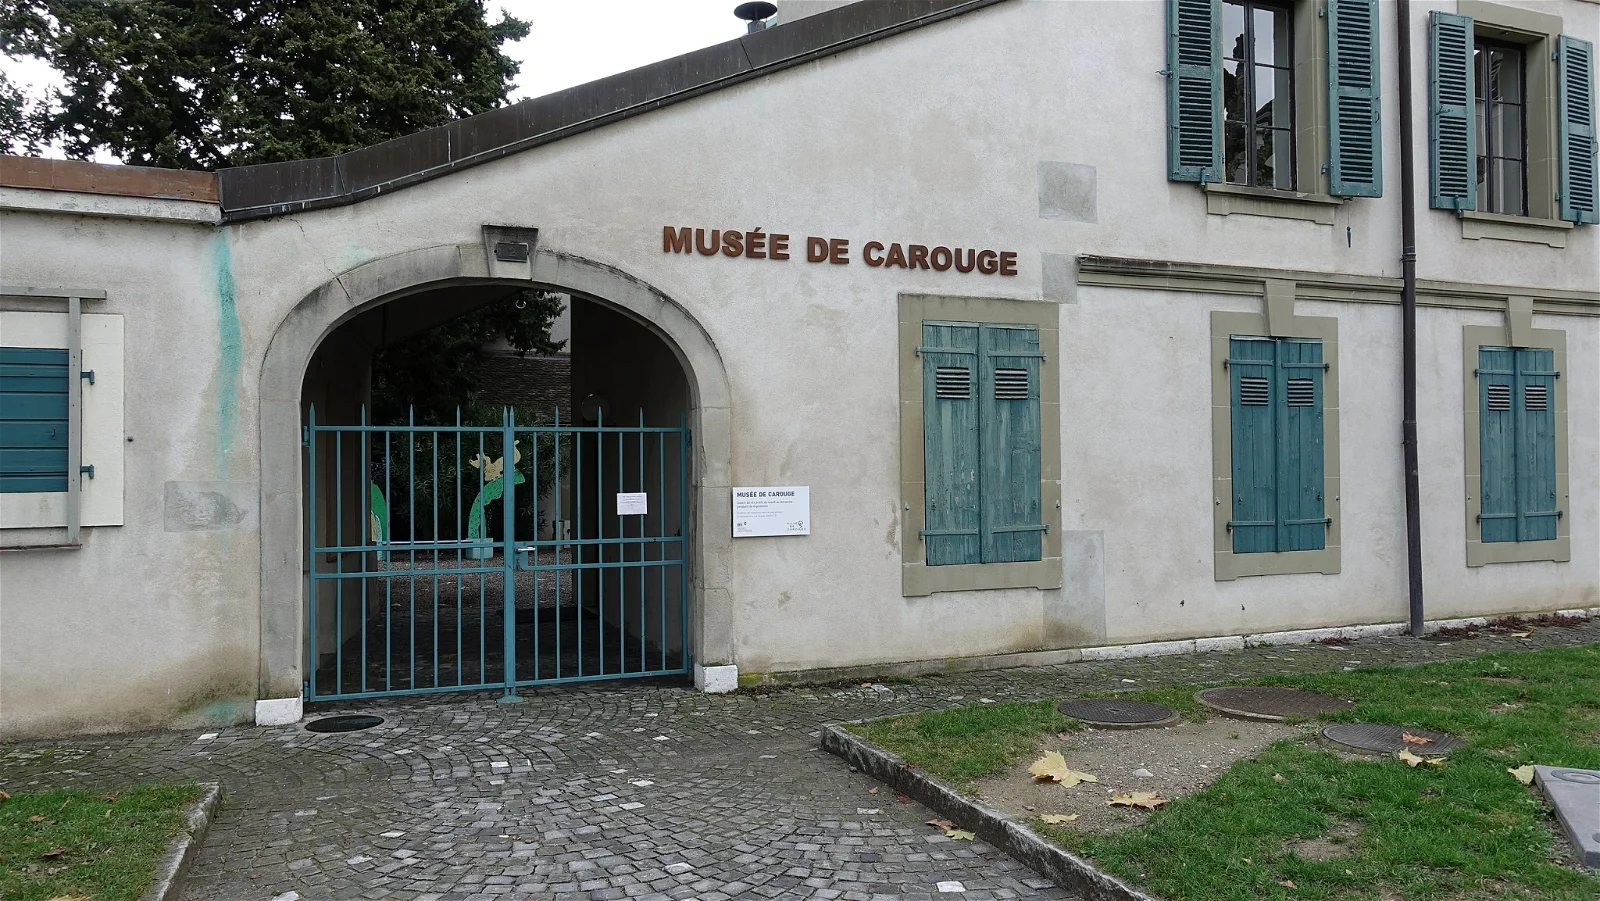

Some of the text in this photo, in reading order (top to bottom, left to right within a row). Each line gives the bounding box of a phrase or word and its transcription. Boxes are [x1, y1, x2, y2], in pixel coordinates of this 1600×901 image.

[508, 246, 516, 256] 2
[663, 226, 1018, 276] MUSÉE DE CAROUGE
